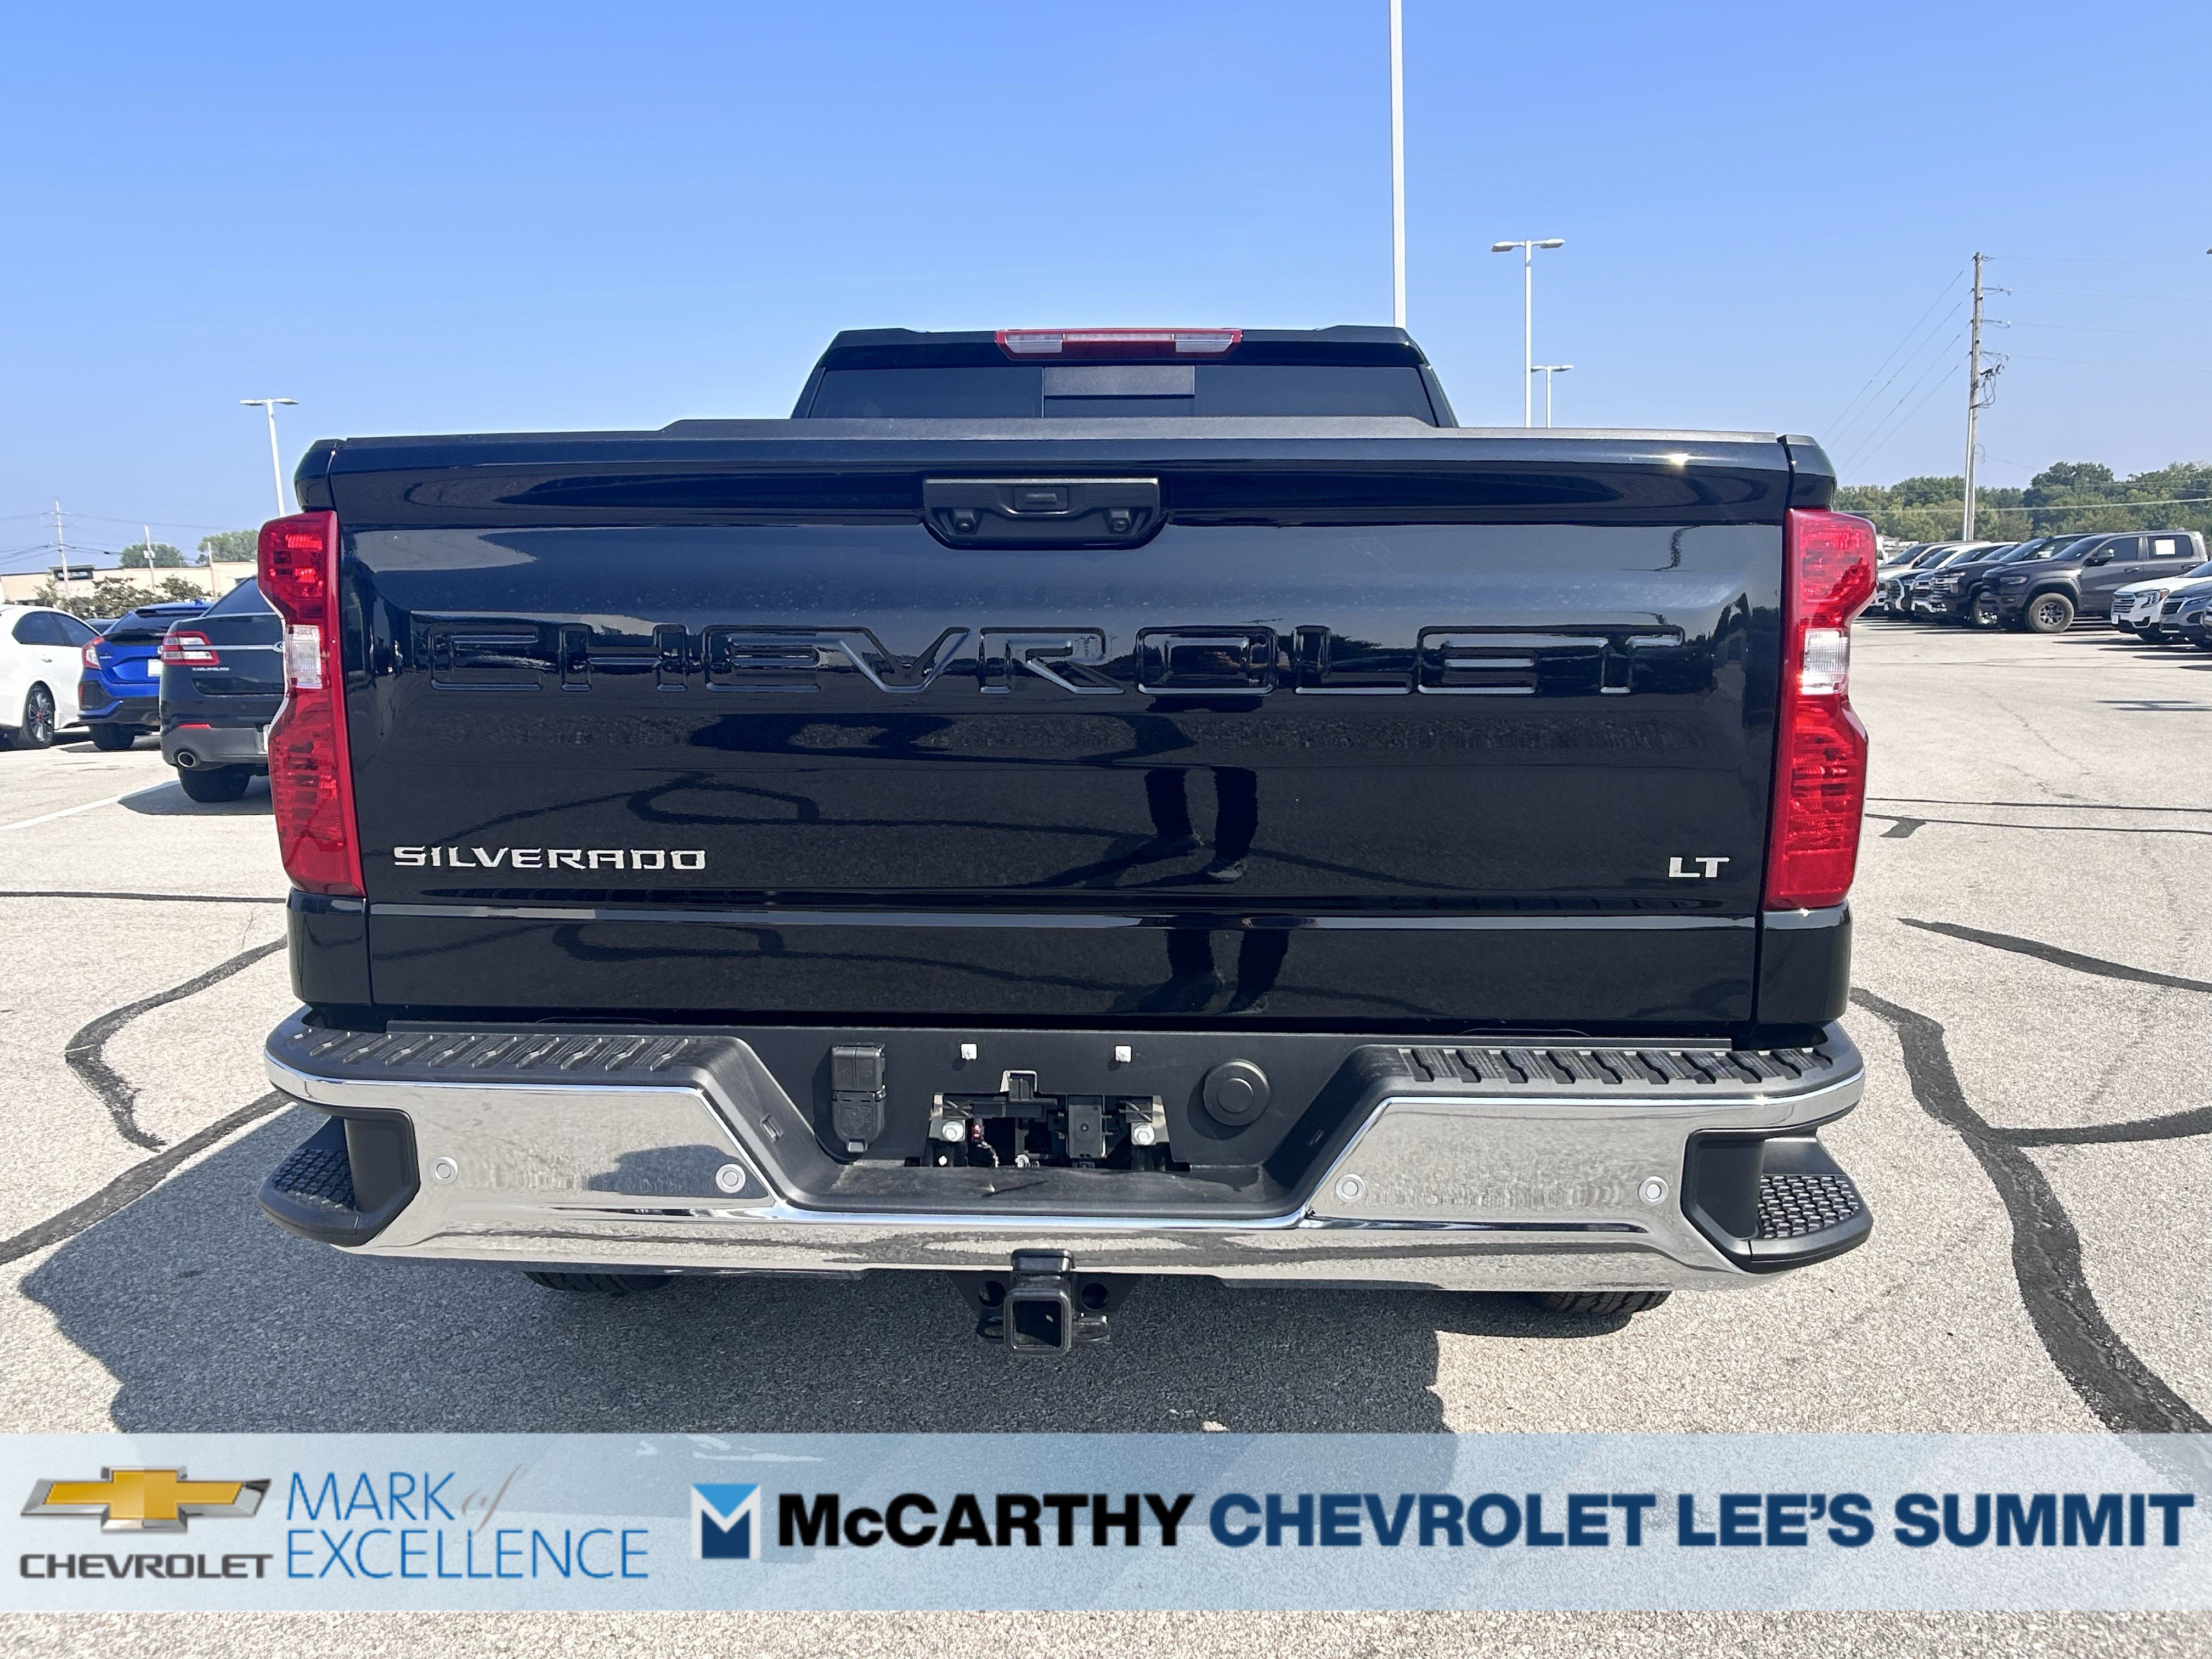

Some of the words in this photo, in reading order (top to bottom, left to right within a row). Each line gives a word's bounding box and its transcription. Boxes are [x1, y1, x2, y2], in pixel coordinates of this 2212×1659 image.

[426, 623, 1686, 696] CHEVROLET
[393, 845, 707, 870] SILVERADO
[1668, 856, 1730, 878] LT
